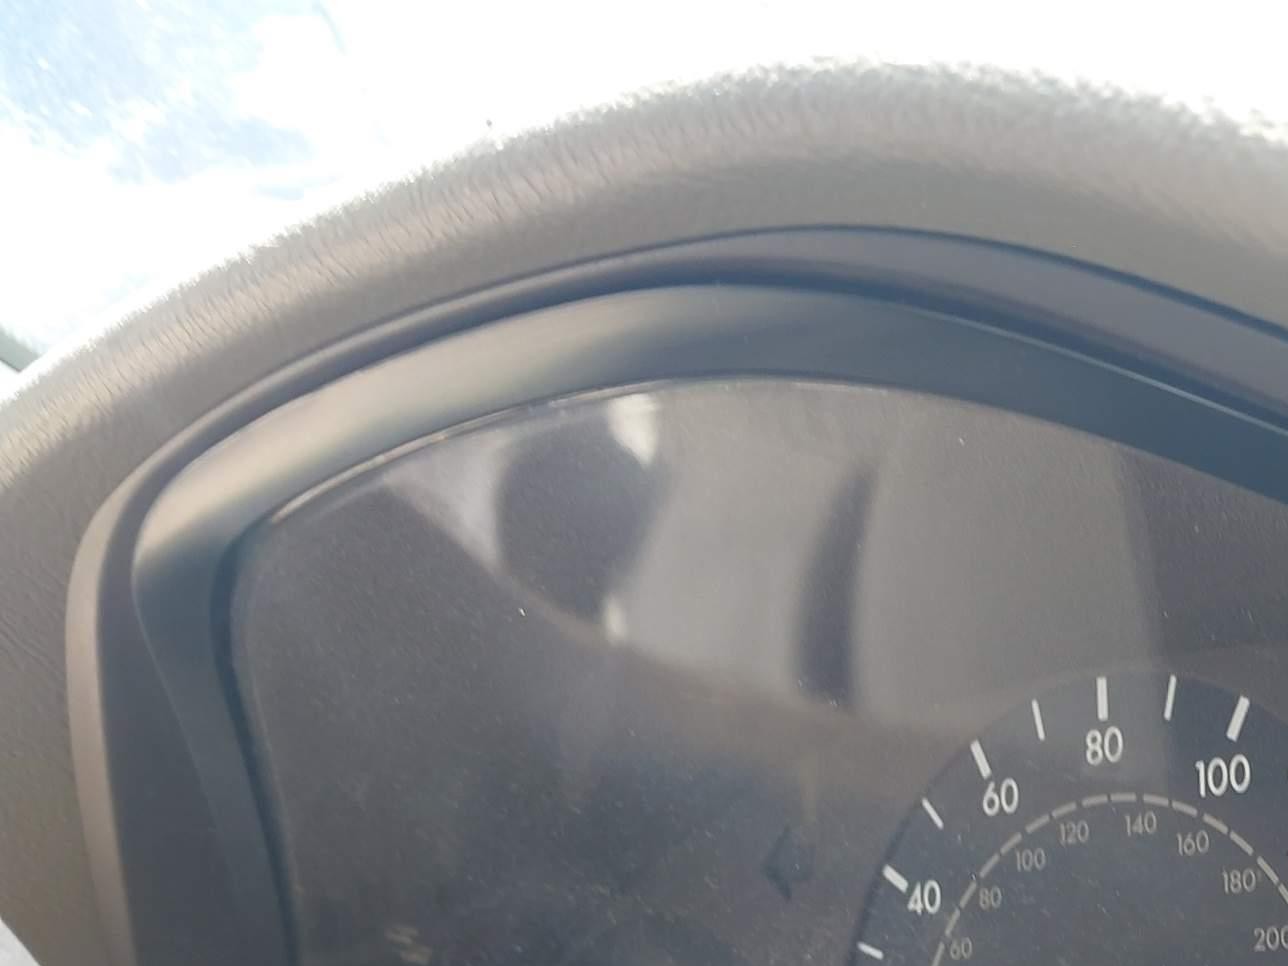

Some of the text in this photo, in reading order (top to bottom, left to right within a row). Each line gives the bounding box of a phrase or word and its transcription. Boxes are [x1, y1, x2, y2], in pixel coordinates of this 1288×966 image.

[1086, 726, 1123, 764] 80
[1196, 754, 1250, 797] 100
[982, 778, 1019, 816] 60
[1058, 819, 1089, 844] 120
[1125, 812, 1157, 835] 140
[1177, 830, 1209, 856] 160
[1015, 847, 1046, 872] 100
[1223, 869, 1256, 894] 180
[908, 880, 941, 914] 40
[979, 887, 1003, 911] 80
[949, 937, 972, 959] 60
